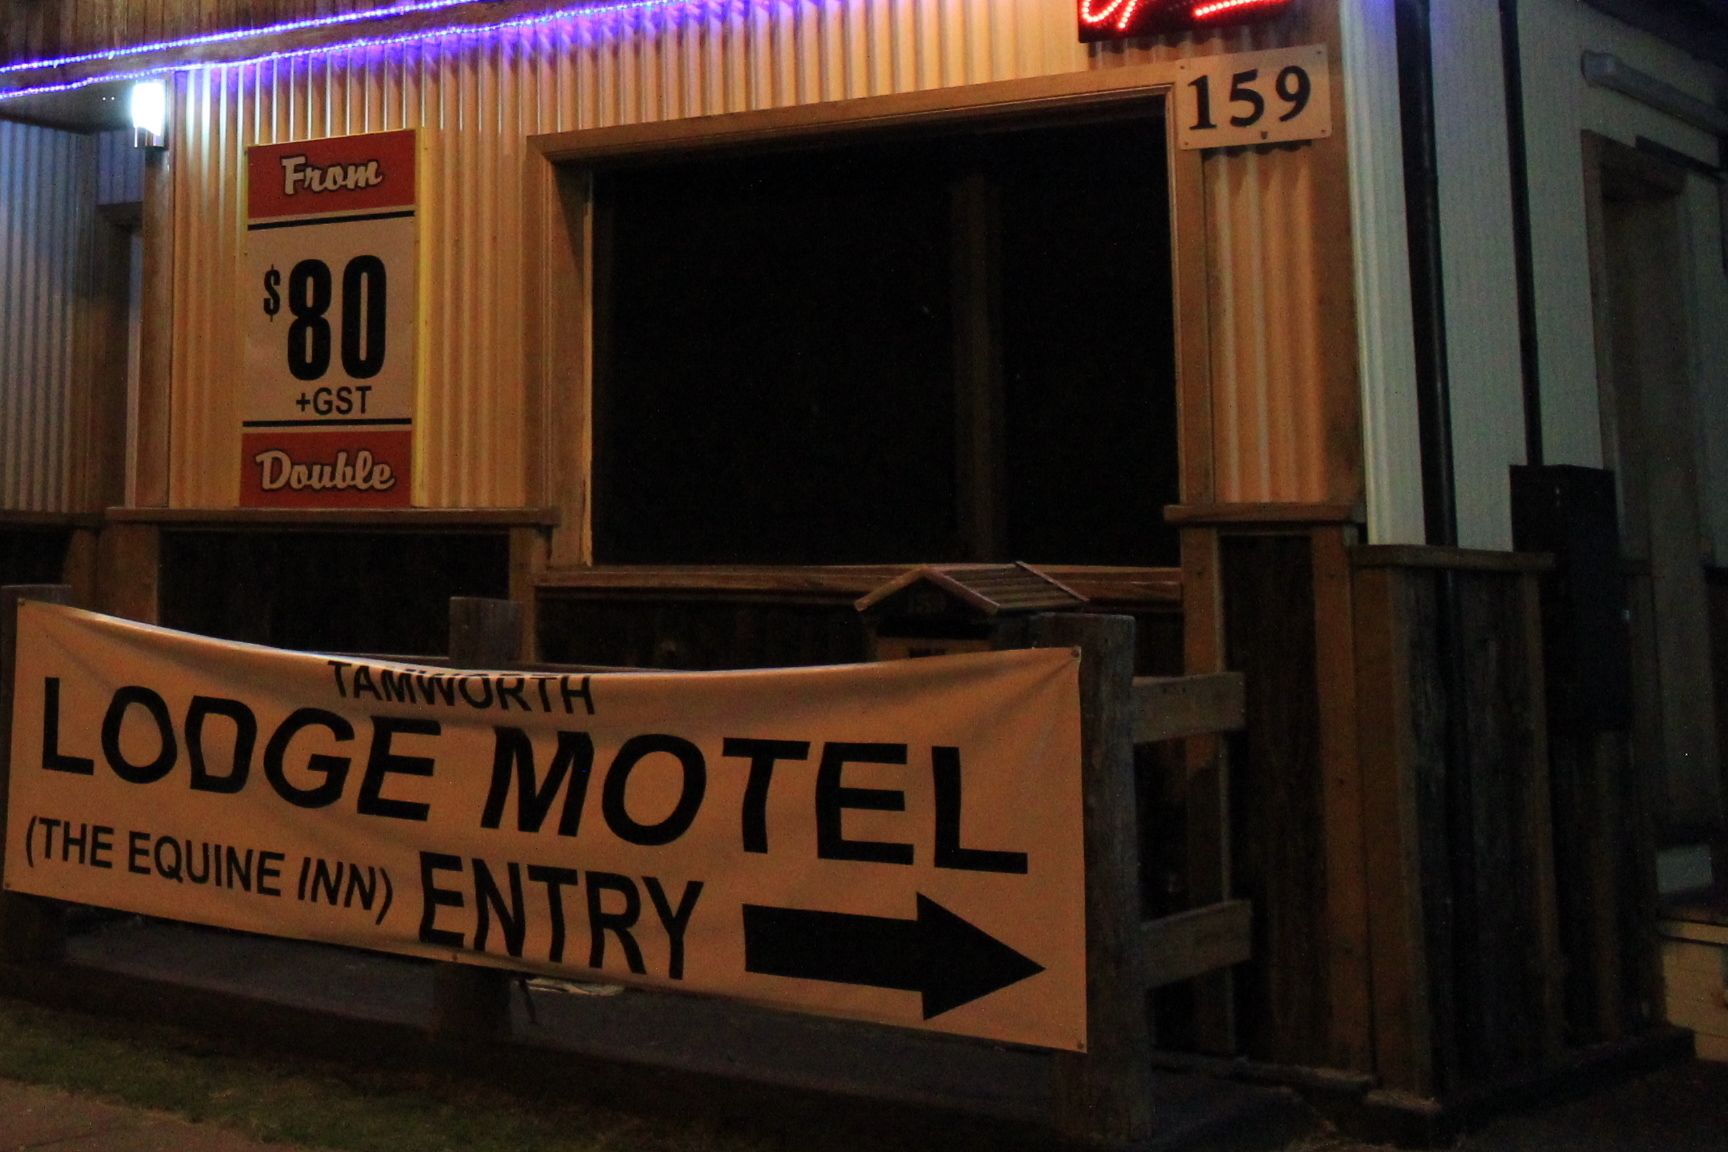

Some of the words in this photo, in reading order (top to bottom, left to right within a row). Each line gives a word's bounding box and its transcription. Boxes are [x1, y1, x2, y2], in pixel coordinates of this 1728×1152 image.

[1187, 65, 1311, 131] 159
[281, 155, 383, 195] From
[263, 254, 387, 381] $80
[295, 385, 372, 416] +GST
[255, 449, 396, 492] Double
[326, 659, 597, 716] TAMWORTH
[40, 676, 442, 822] LODGE
[480, 725, 1029, 875] MOTEL
[25, 815, 114, 869] (THE
[127, 830, 286, 898] EQUINE
[297, 856, 394, 926] INN)
[418, 849, 705, 981] ENTRY
